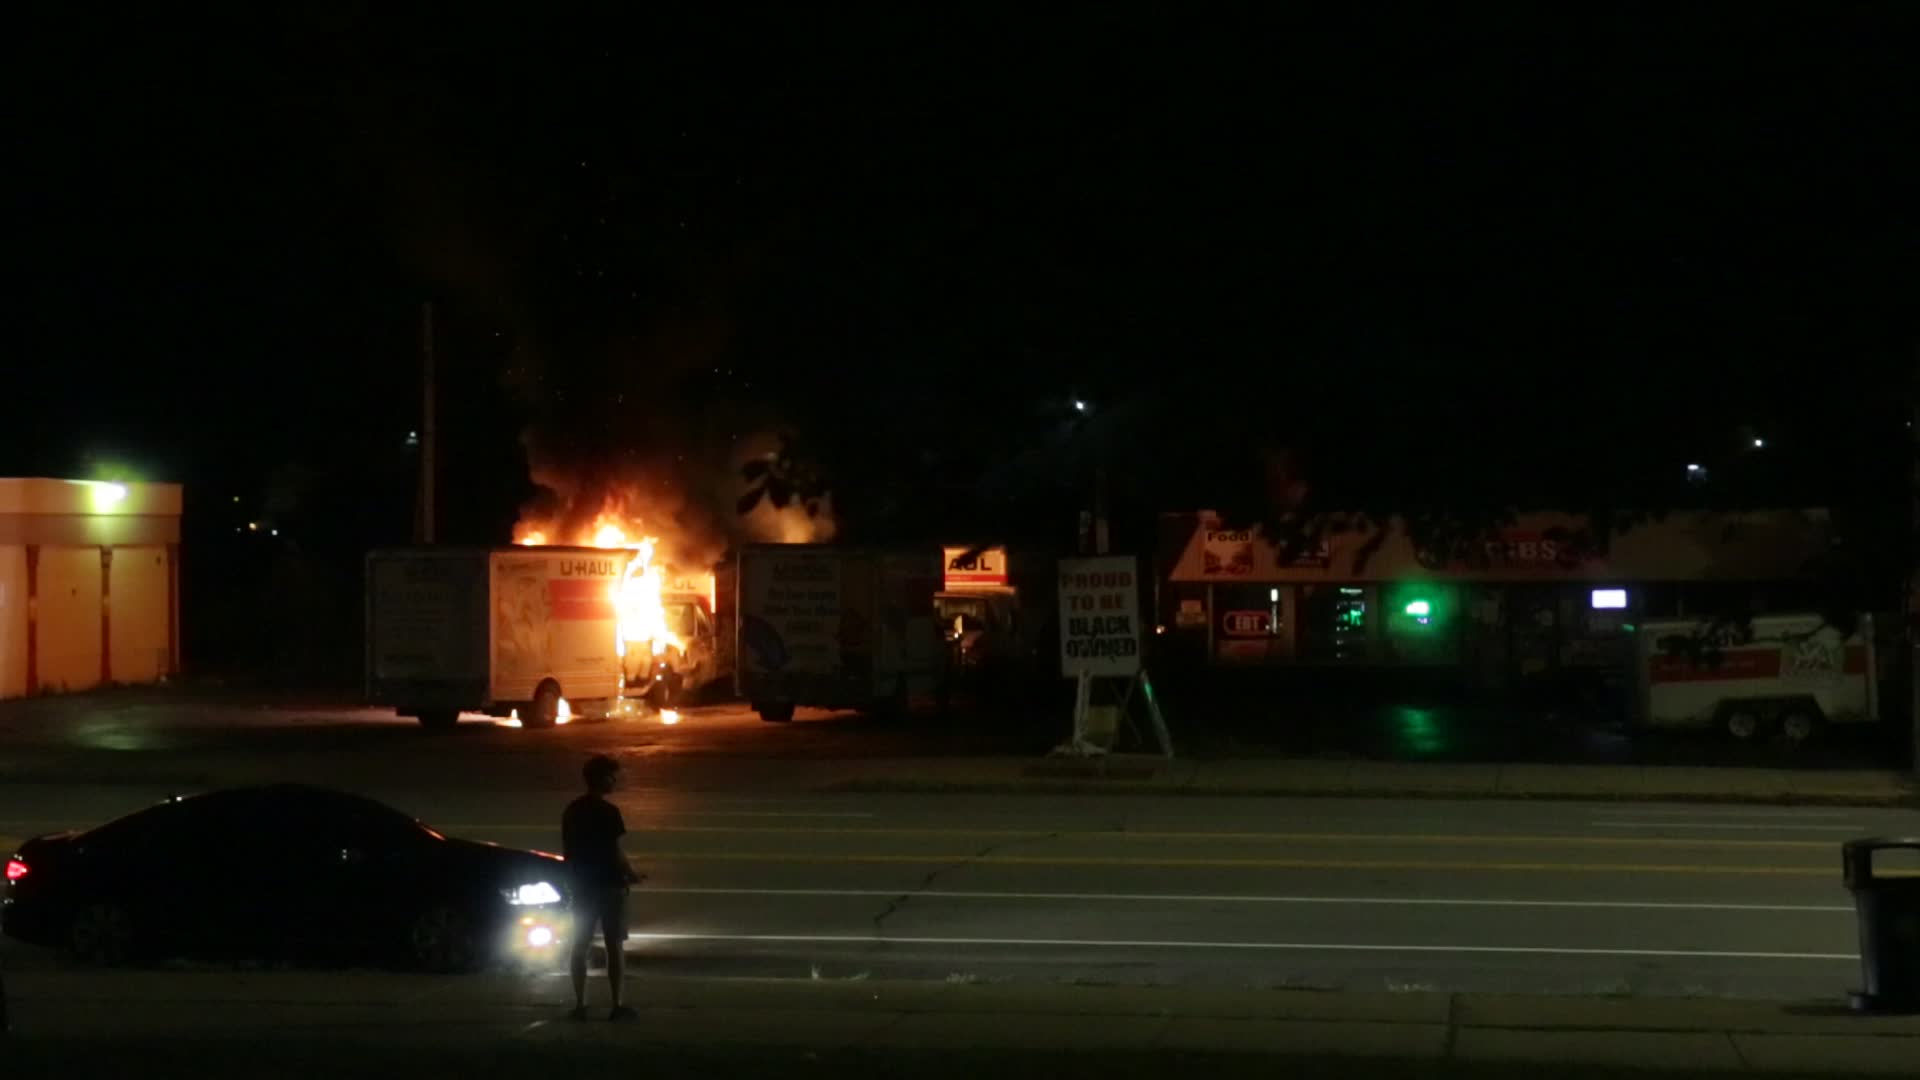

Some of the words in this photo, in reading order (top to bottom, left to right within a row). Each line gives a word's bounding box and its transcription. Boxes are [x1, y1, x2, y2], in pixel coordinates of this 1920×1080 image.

[1207, 531, 1248, 542] Food
[1061, 570, 1132, 589] PROUD
[1067, 594, 1095, 611] TO
[1069, 616, 1132, 637] BLACK
[1066, 638, 1137, 657] OWNED
